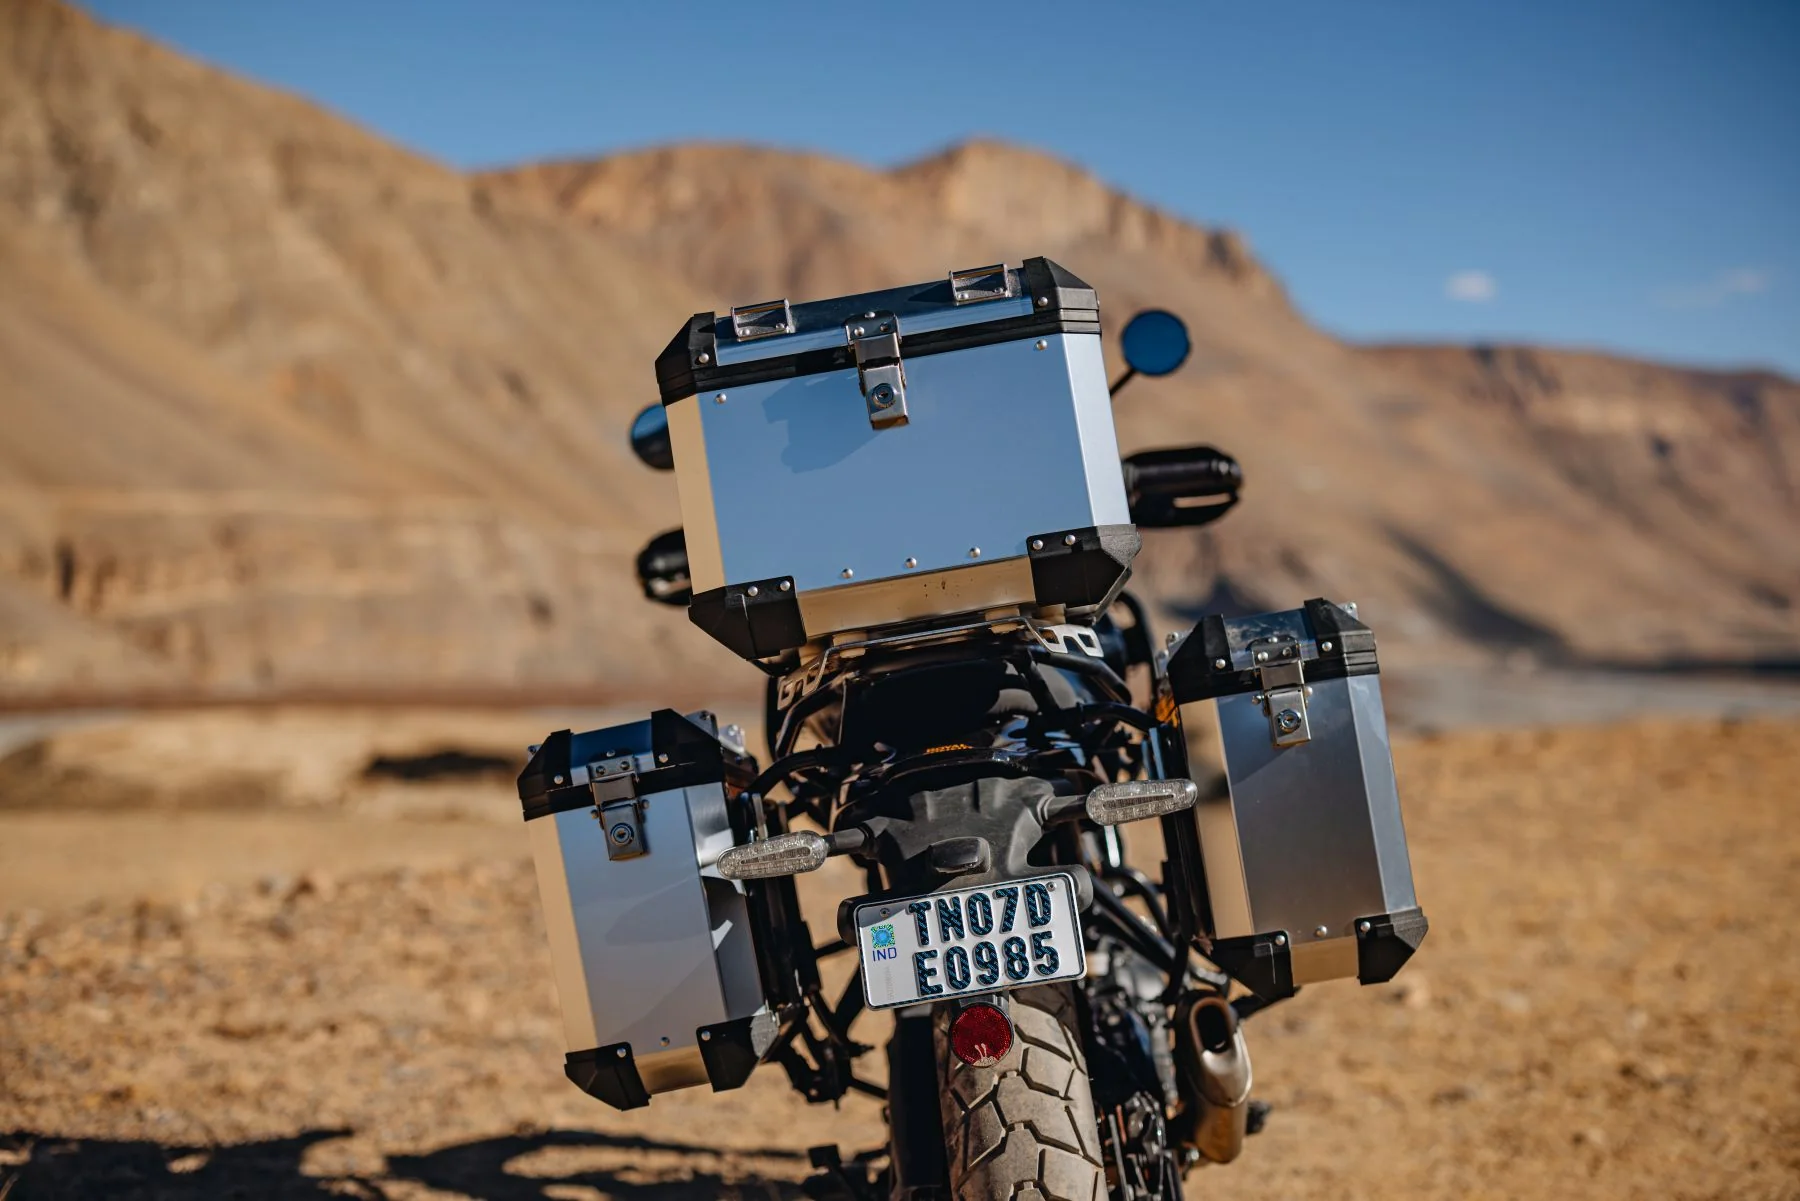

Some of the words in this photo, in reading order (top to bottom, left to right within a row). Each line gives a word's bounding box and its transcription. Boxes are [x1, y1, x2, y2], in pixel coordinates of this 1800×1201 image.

[908, 883, 1052, 946] TN07D
[872, 947, 897, 961] IND
[913, 931, 1060, 996] E0985
